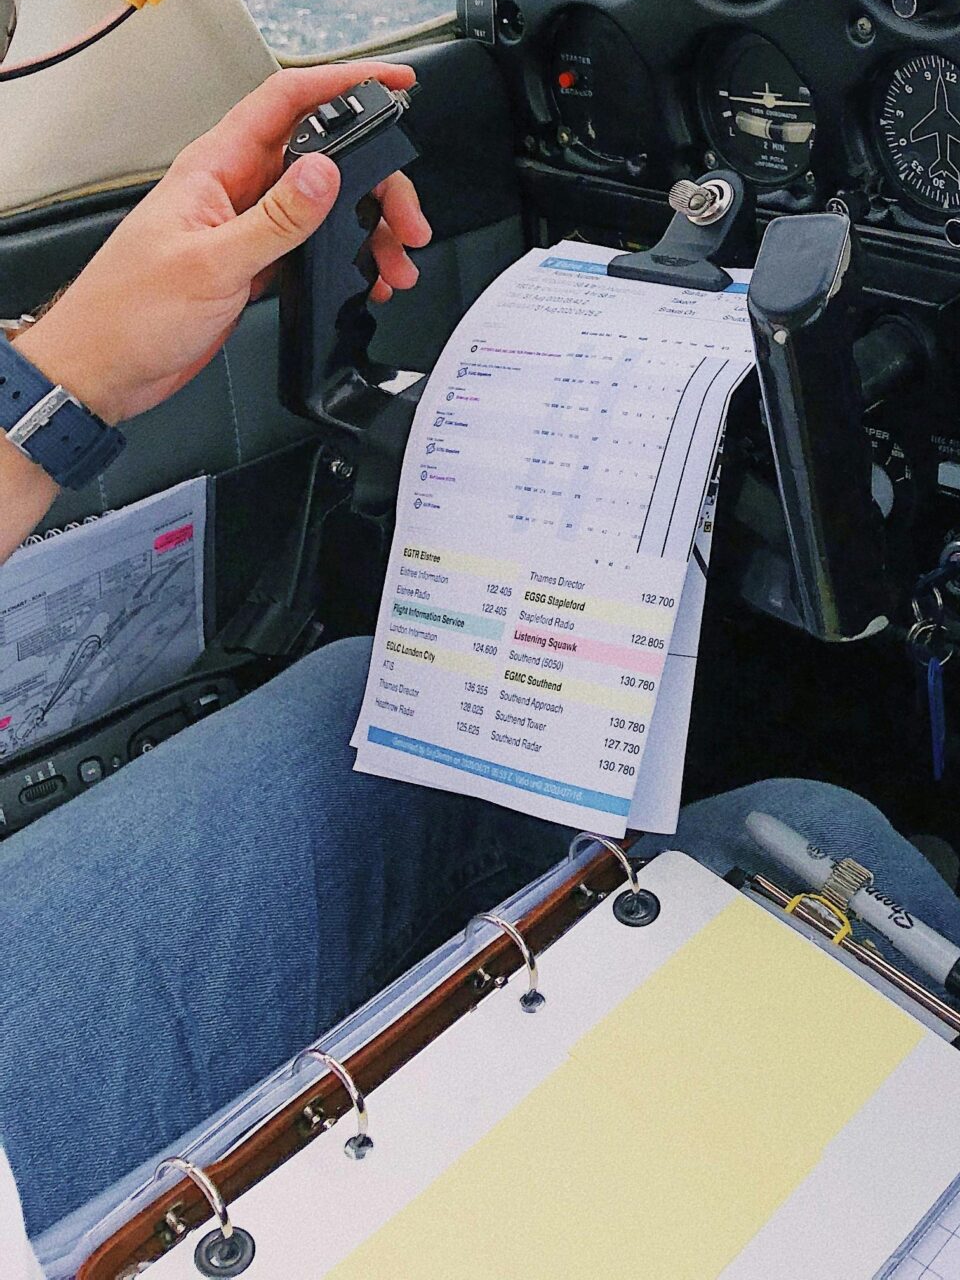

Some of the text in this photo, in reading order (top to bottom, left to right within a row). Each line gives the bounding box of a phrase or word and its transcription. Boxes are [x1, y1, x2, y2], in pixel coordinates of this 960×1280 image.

[404, 548, 440, 563] EGTR Elstree
[530, 571, 585, 590] Thames Director
[524, 591, 586, 612] EGSG Stapleford
[641, 593, 675, 608] 132.700
[409, 607, 441, 621] Information
[441, 614, 465, 628] Service
[519, 610, 575, 630] Stapleford Radio
[514, 630, 577, 653] Listening Squawk
[631, 634, 665, 650] 122.805
[402, 644, 423, 658] London
[423, 650, 435, 663] City
[509, 650, 564, 671] Southend (5050)
[504, 670, 562, 692] EGMC Southend
[620, 675, 655, 692] 130.780
[500, 690, 564, 714] Southend Approach
[495, 710, 547, 732] Southend Tower
[609, 717, 645, 734] 130.780
[491, 730, 543, 753] Southend Radar
[604, 738, 640, 755] 127.730
[599, 759, 635, 776] 130.780
